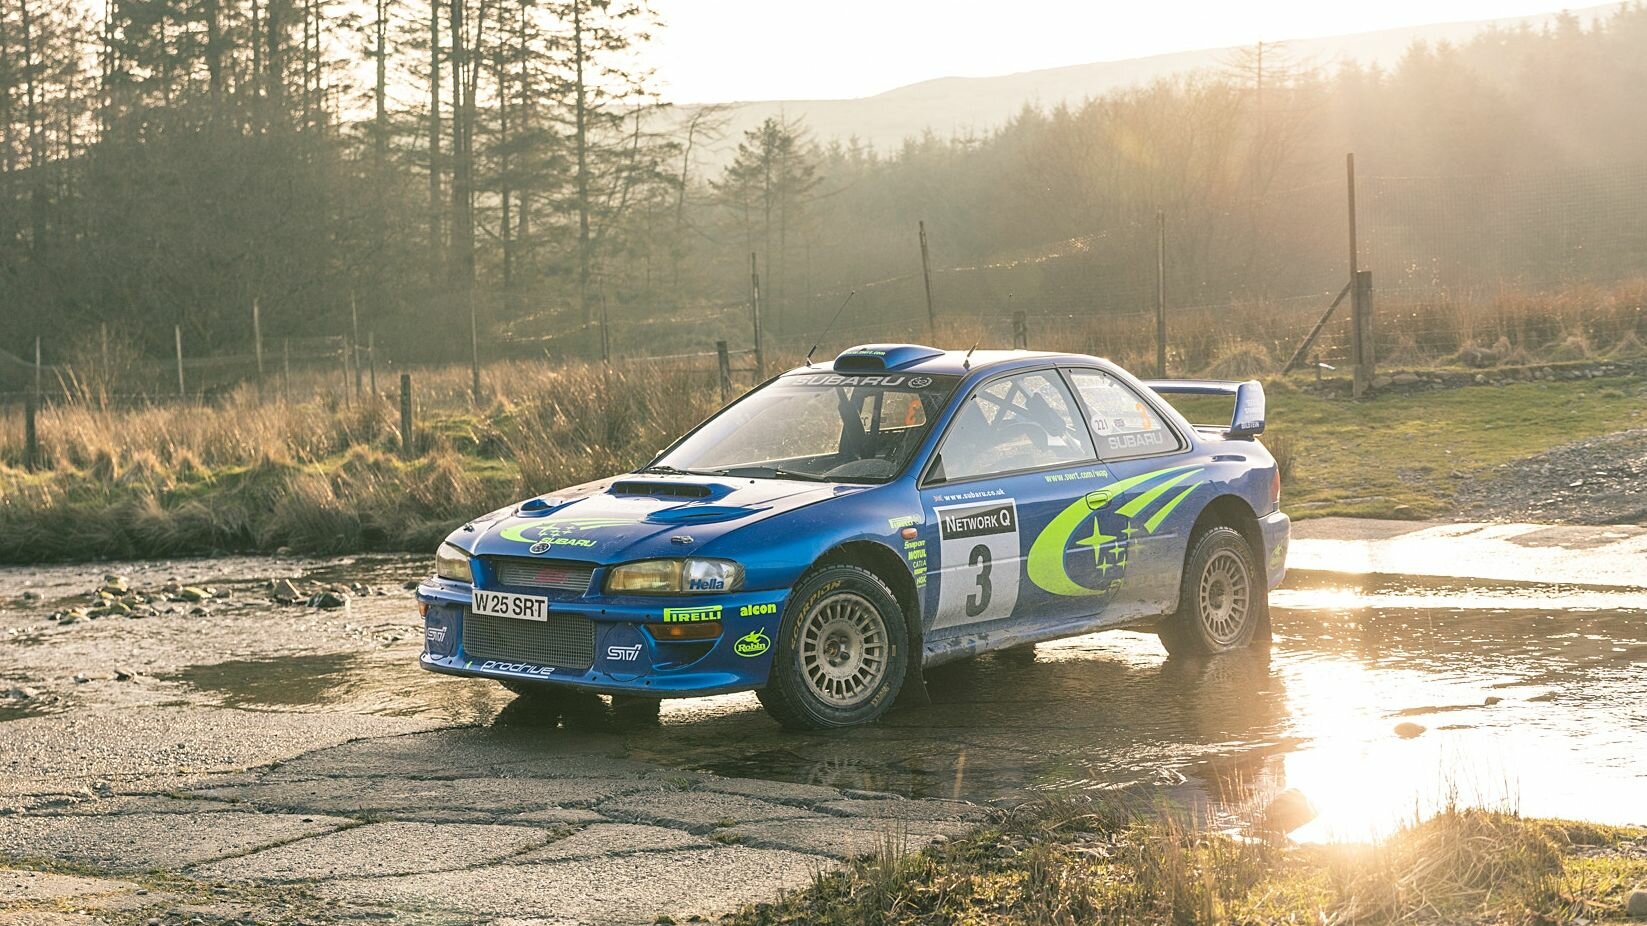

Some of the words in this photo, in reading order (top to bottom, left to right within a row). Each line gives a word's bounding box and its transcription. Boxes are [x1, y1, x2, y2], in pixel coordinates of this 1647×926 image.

[792, 376, 906, 387] SUBARU
[1136, 402, 1153, 431] 3
[1108, 432, 1164, 449] SUBARU
[944, 488, 1006, 501] www.subaru.co.uk
[945, 515, 999, 533] NETWORK
[999, 509, 1011, 526] Q
[539, 537, 597, 547] SUBARU
[689, 579, 724, 590] Hella
[966, 544, 992, 617] 3
[474, 593, 489, 611] W
[491, 595, 509, 614] 25
[512, 597, 546, 618] SRT
[663, 605, 723, 622] PIRELLI
[739, 603, 777, 617] alcon
[791, 580, 842, 650] SCORPION
[737, 642, 766, 653] Robin
[480, 660, 555, 676] prodrive
